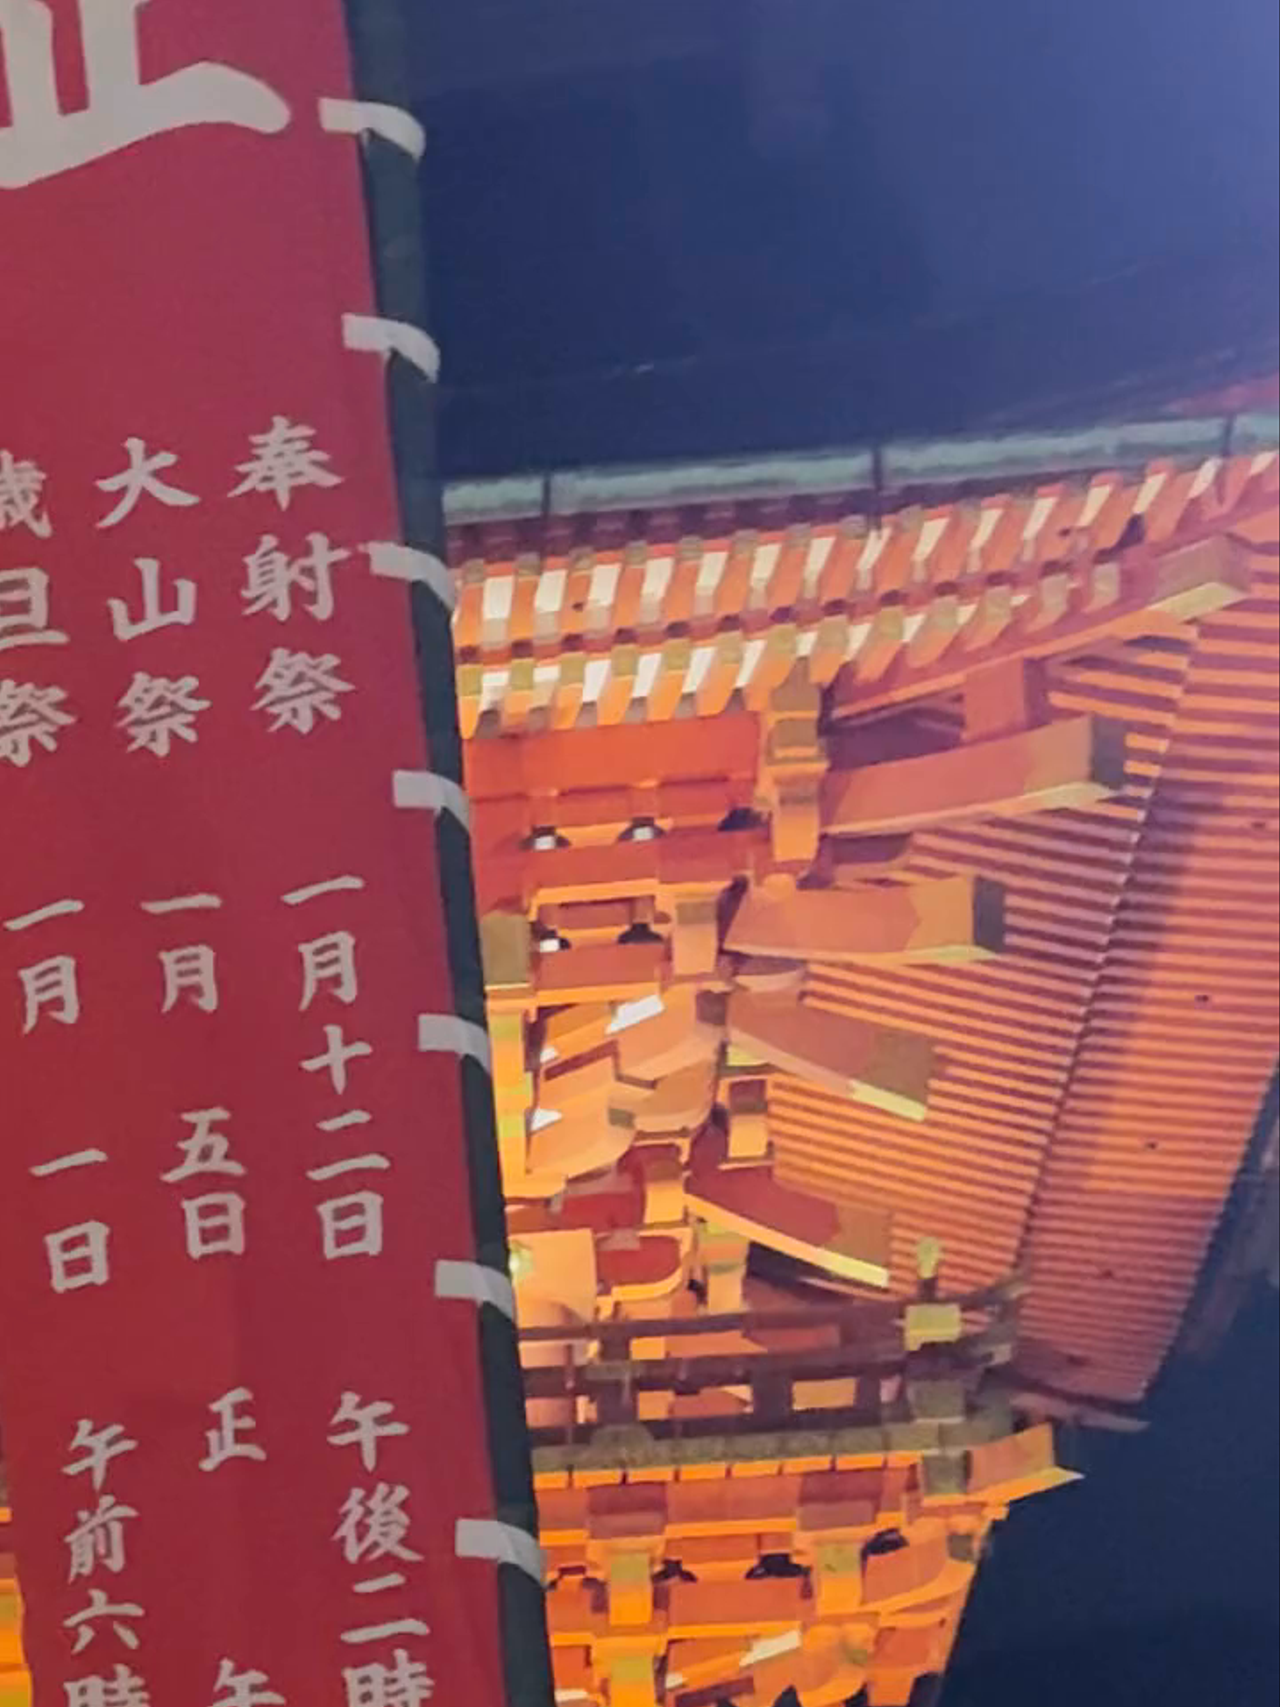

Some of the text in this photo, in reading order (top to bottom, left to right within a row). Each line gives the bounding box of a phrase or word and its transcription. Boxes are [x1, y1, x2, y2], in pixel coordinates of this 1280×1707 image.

[96, 436, 212, 759] 大山祭
[227, 415, 356, 735] 奉射祭
[280, 874, 391, 1261] 一月十二日
